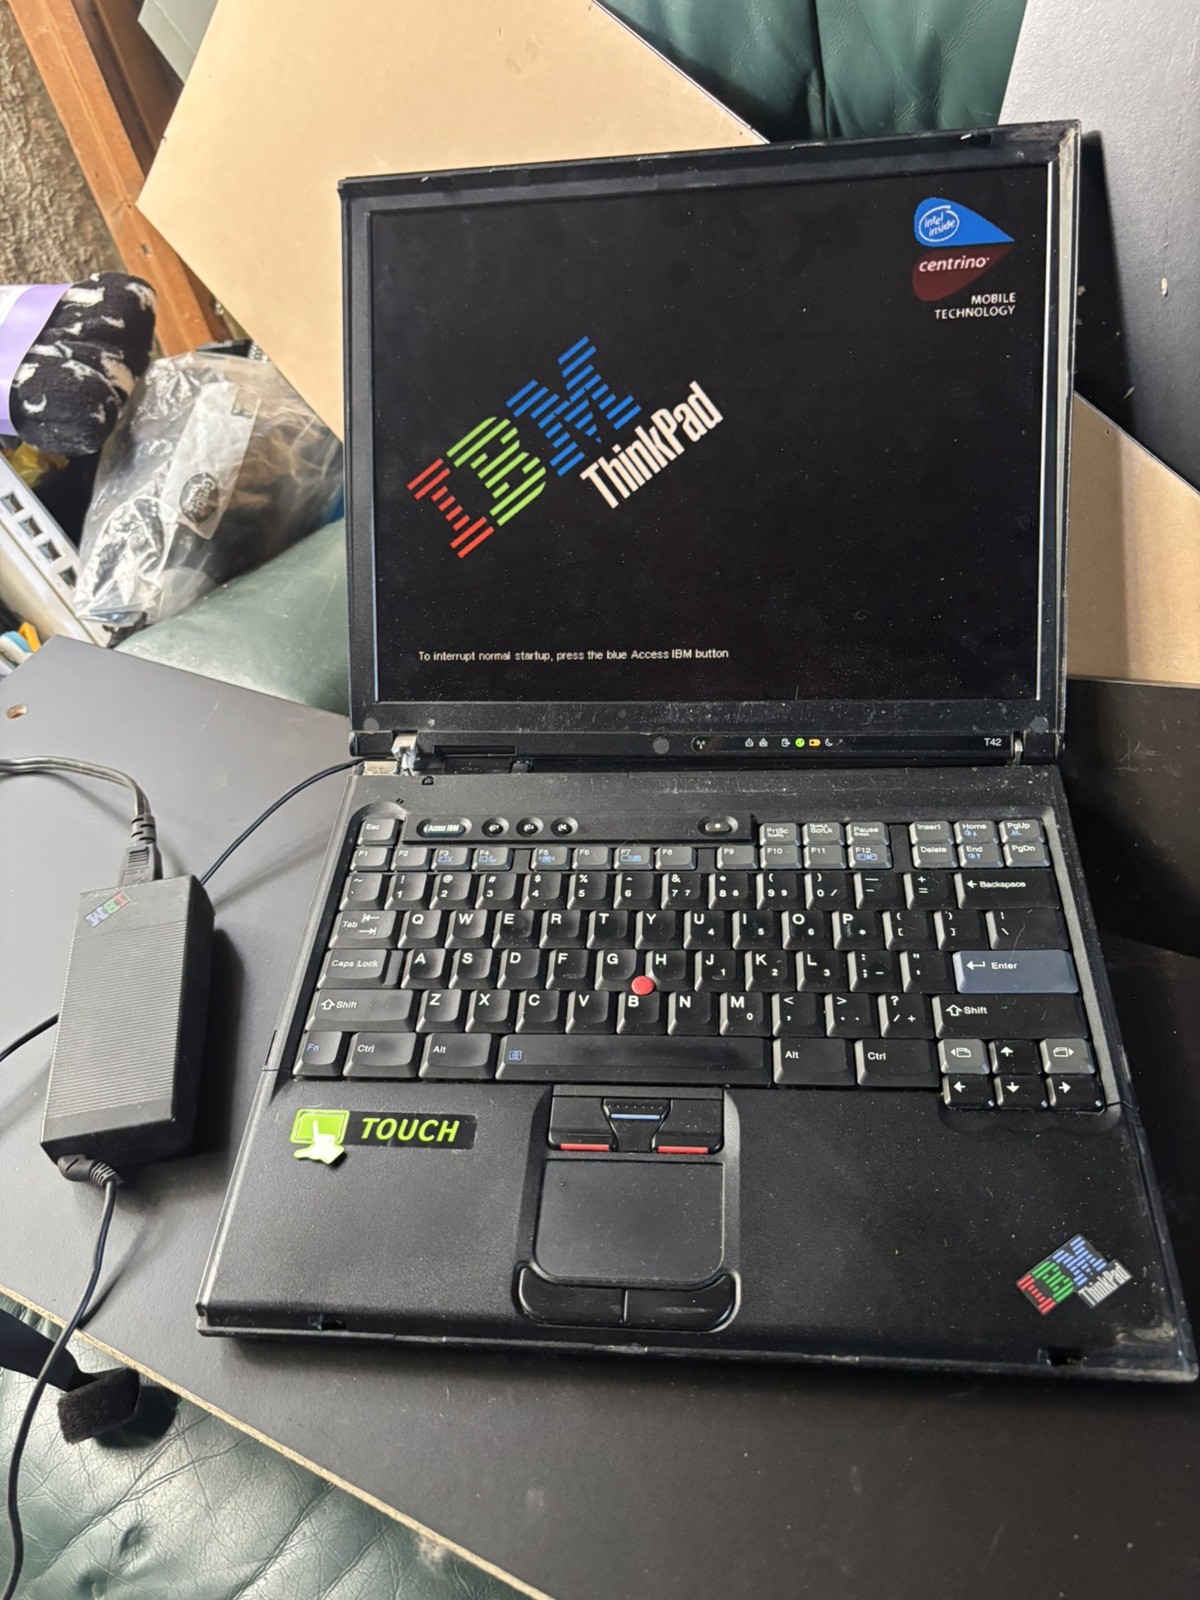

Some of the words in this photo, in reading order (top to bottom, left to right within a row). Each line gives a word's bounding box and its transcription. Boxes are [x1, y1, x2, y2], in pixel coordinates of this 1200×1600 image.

[925, 212, 944, 227] intel
[929, 219, 955, 237] inside
[919, 255, 986, 272] centrino
[971, 293, 1016, 304] MOBILE
[935, 305, 1015, 319] TECHNOLOGY
[407, 336, 642, 558] IBM
[580, 381, 723, 509] ThinkPad
[419, 651, 430, 660] To
[434, 651, 475, 661] interrupt
[479, 651, 510, 660] normal
[515, 651, 553, 662] startup,
[557, 652, 584, 661] press
[588, 650, 603, 659] the
[607, 650, 627, 659] blue
[631, 650, 668, 659] Access
[672, 650, 692, 659] IBM
[695, 649, 729, 658] button
[625, 889, 631, 897] 6
[720, 889, 726, 897] 8
[768, 889, 775, 897] 9
[412, 914, 424, 925] Q
[459, 914, 473, 924] W
[504, 913, 514, 924] E
[551, 913, 562, 924] R
[599, 913, 609, 924] T
[646, 913, 656, 924] Y
[694, 913, 704, 924] U
[793, 914, 805, 924] O
[843, 914, 853, 924] P
[415, 954, 426, 964] A
[463, 953, 472, 963] S
[510, 954, 521, 963] D
[559, 953, 567, 963] F
[607, 953, 618, 964] G
[656, 954, 666, 964] H
[706, 954, 714, 965] J
[756, 954, 767, 965] K
[807, 954, 816, 965] L
[332, 960, 354, 968] Caps
[336, 1001, 357, 1009] Shift
[430, 995, 440, 1005] Z
[479, 995, 490, 1005] X
[529, 995, 539, 1006] C
[579, 995, 590, 1006] V
[628, 996, 638, 1007] B
[680, 996, 690, 1007] N
[731, 997, 744, 1008] M
[964, 1007, 987, 1015] Shift
[308, 1044, 319, 1052] Fn
[358, 1045, 374, 1053] Ctrl
[433, 1046, 446, 1054] Alt
[786, 1051, 798, 1059] Alt
[868, 1052, 886, 1060] Ctrl
[362, 1118, 459, 1142] TOUCH
[1017, 1236, 1107, 1315] IBM
[1078, 1262, 1132, 1306] ThinkPad
